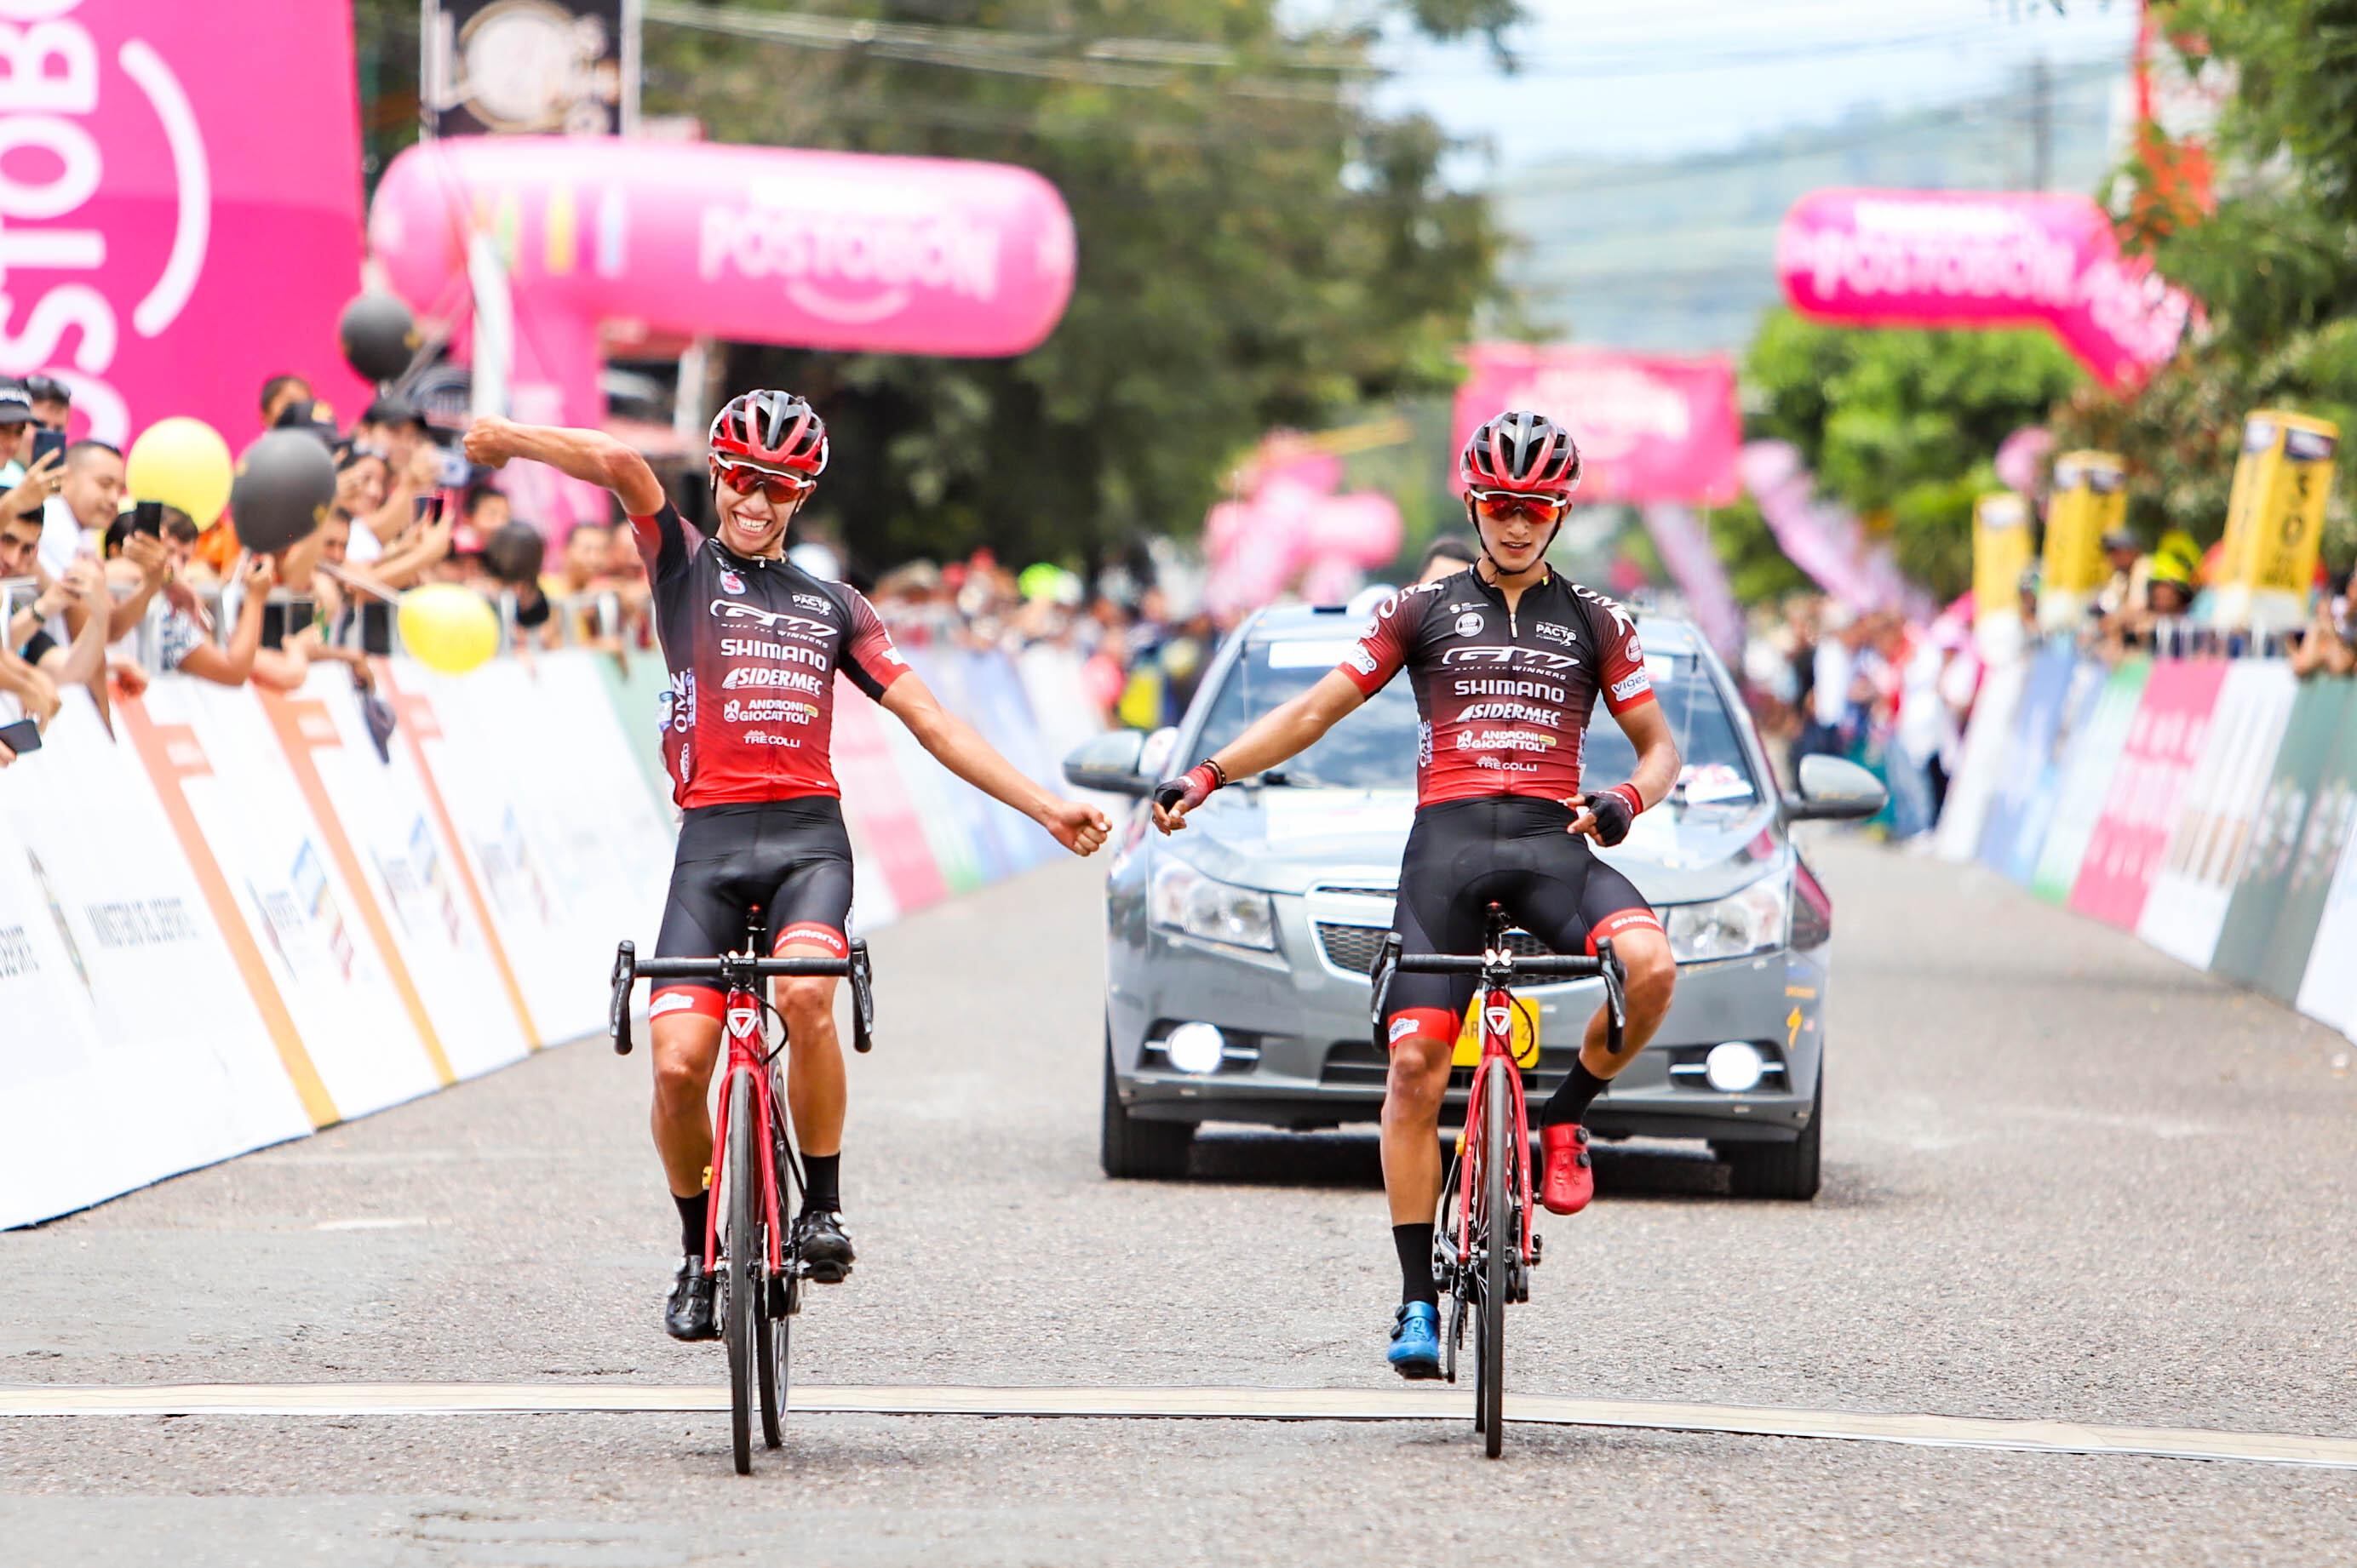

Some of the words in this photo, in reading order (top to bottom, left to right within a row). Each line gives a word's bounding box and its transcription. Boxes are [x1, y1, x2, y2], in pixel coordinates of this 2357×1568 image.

[777, 629, 829, 649] WINNERS
[1535, 624, 1577, 644] PACTO
[720, 638, 827, 672] SHIMANO
[737, 667, 823, 695] SIDERMEC
[1511, 665, 1567, 681] WINNERS
[1454, 679, 1565, 703] SHIMANO
[748, 699, 804, 712] ANDRONI
[1472, 703, 1562, 726] SIDERMEC
[739, 710, 810, 724] GIOCATTOLI
[1481, 730, 1539, 741] ANDRONI
[1471, 739, 1546, 753] GIOCATTOLI
